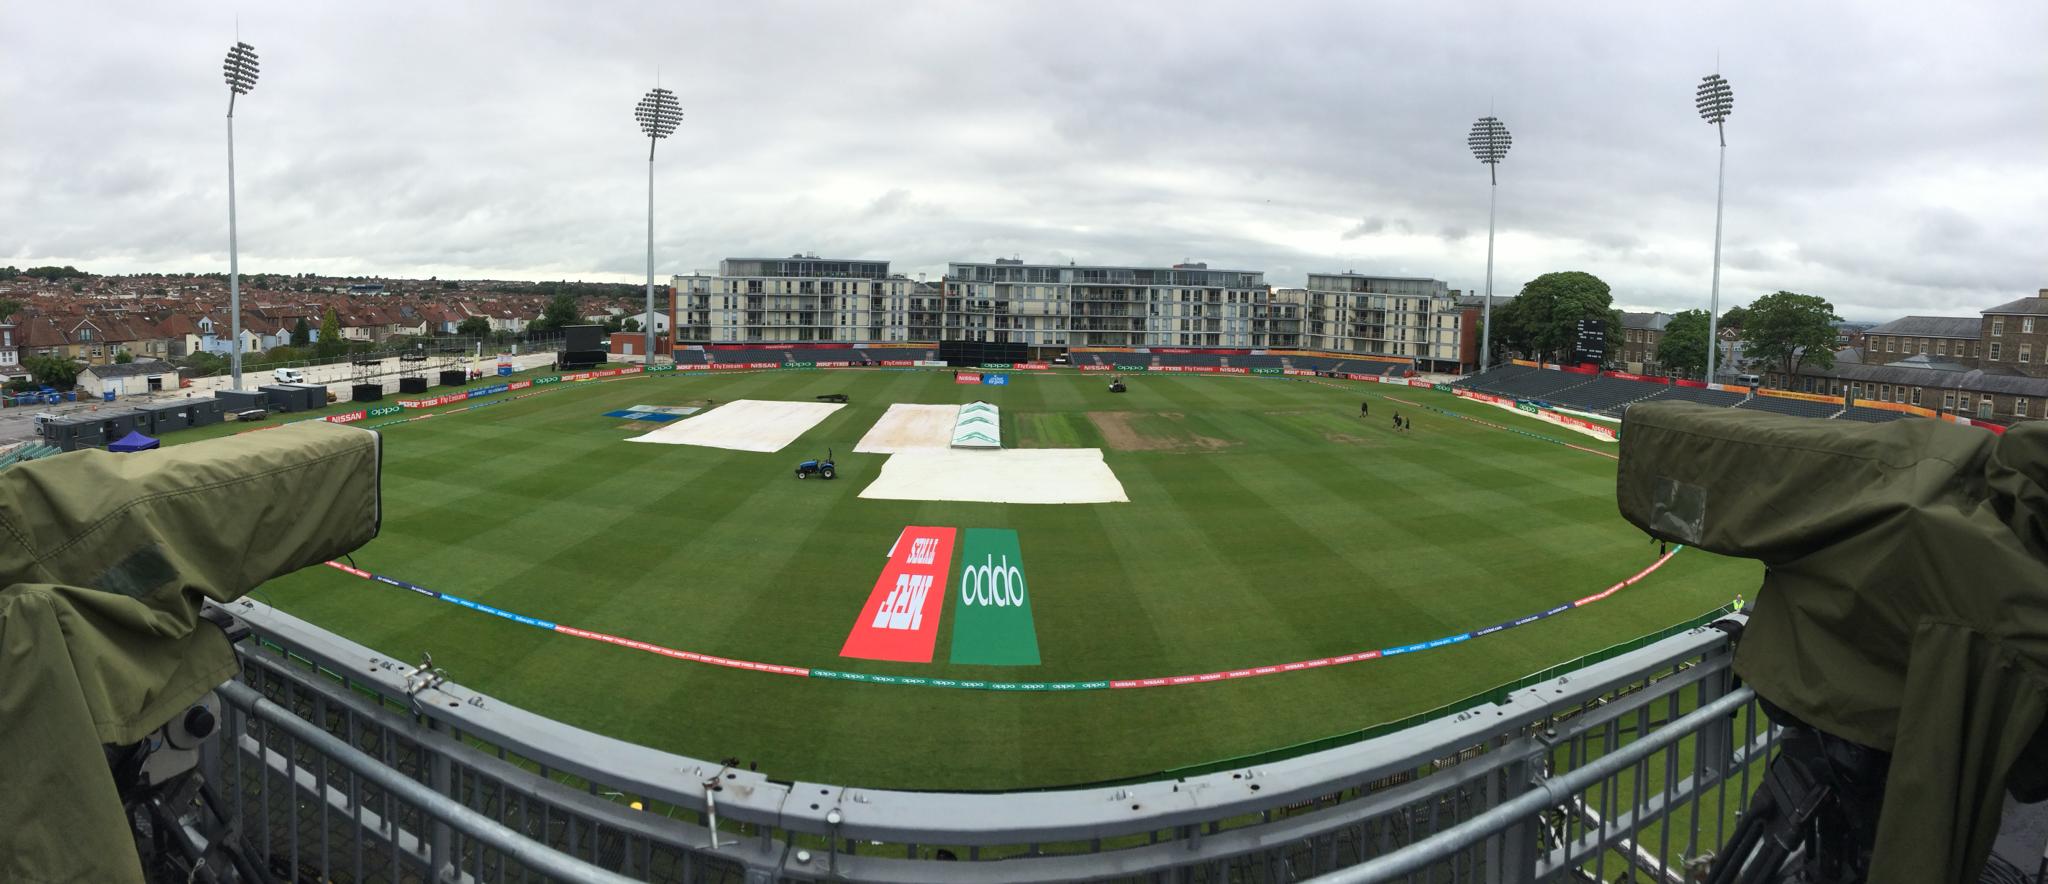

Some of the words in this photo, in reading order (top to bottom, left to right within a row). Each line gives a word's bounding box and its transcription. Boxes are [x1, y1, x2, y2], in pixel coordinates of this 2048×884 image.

[536, 376, 558, 384] oppo
[512, 381, 530, 390] NISSAN
[371, 406, 400, 416] oppo
[1520, 404, 1535, 412] oppo
[331, 413, 362, 423] NISSAN
[1592, 425, 1612, 436] NISSAN
[872, 573, 934, 631] MRF
[1335, 655, 1354, 663] NISSAN
[1358, 651, 1377, 660] NISSAN
[1285, 663, 1304, 671] NISSAN
[1230, 670, 1250, 678] NISSAN
[1144, 678, 1165, 686] NISSAN
